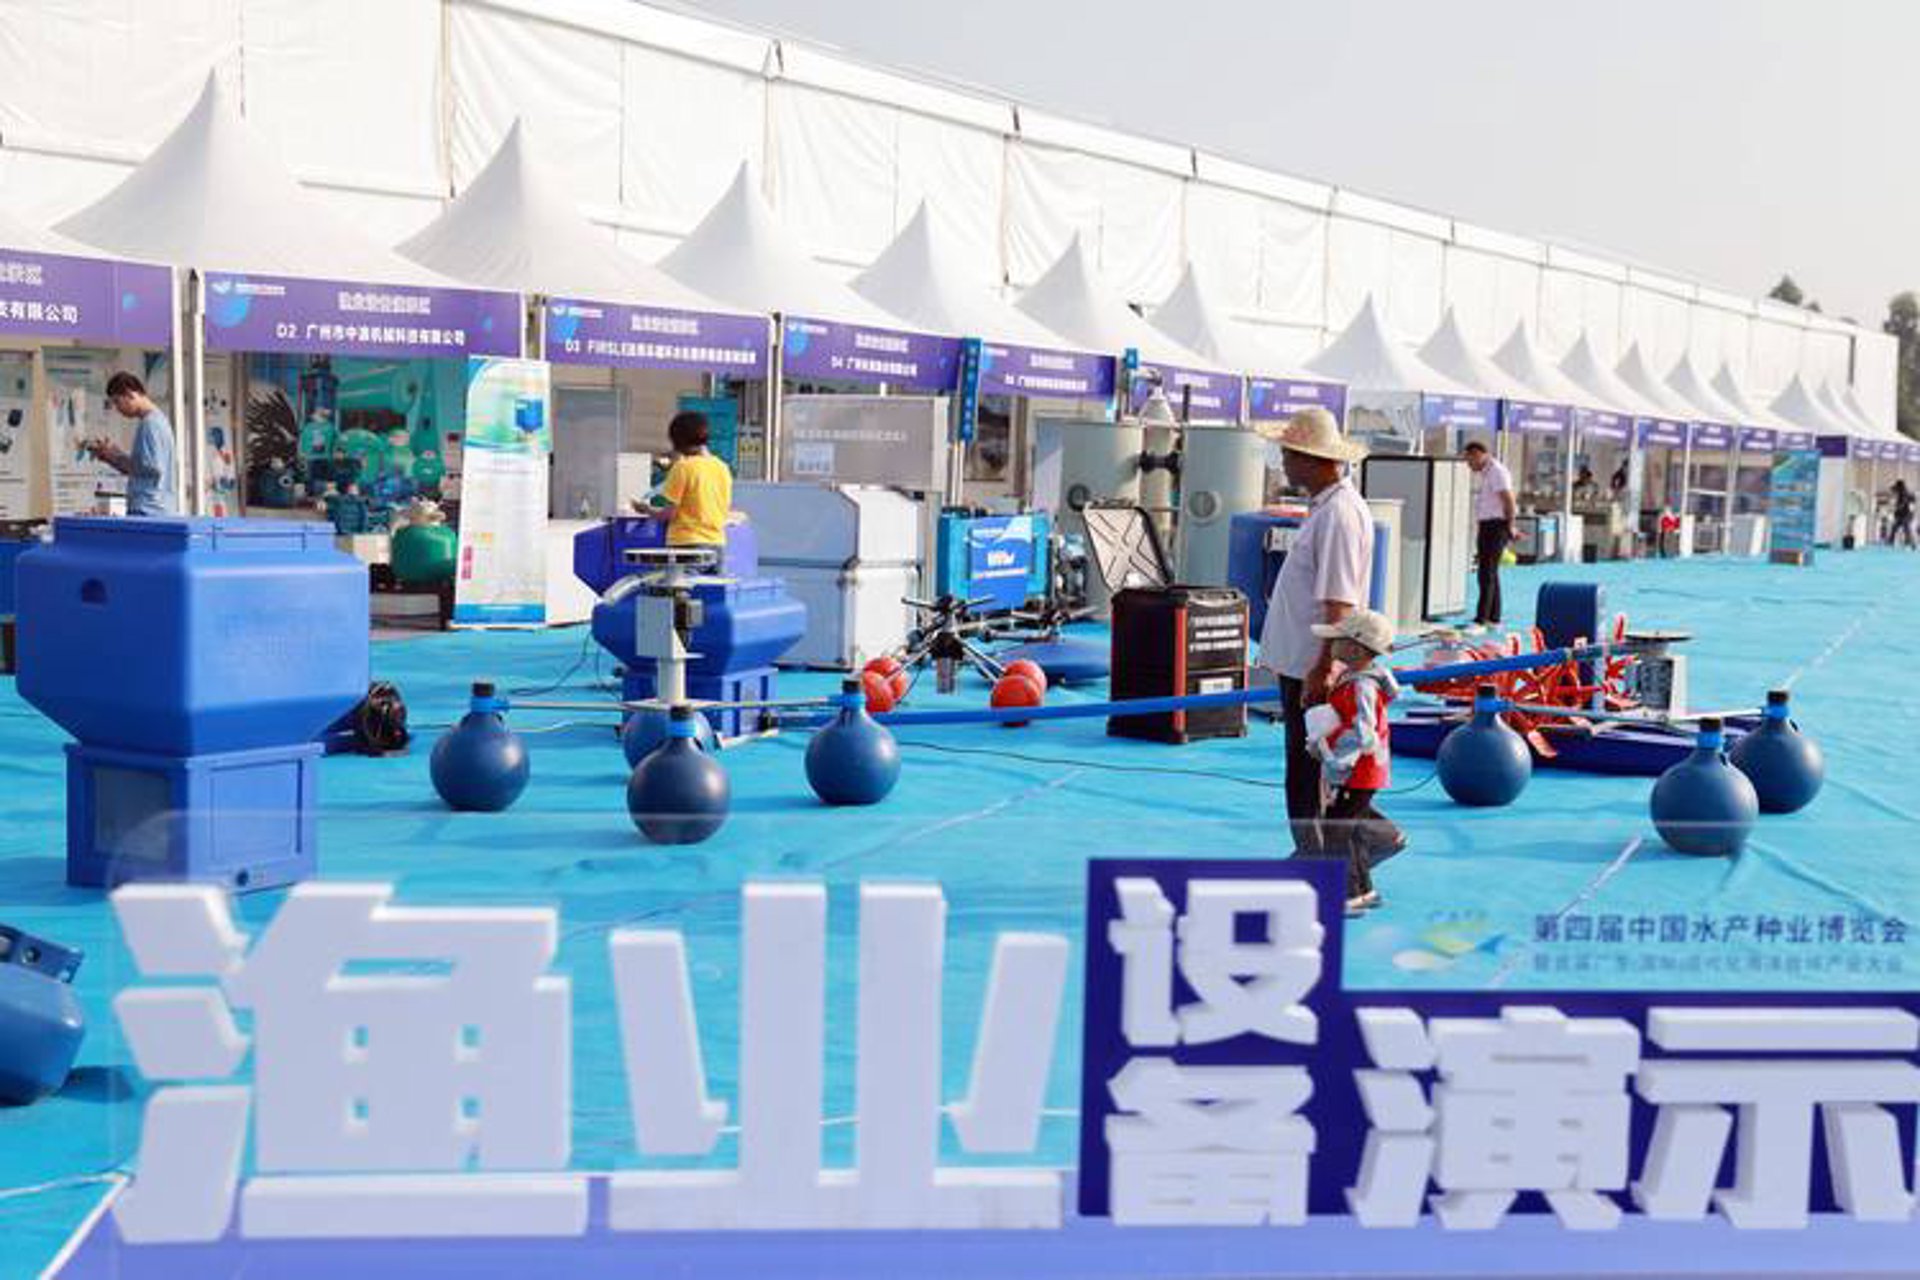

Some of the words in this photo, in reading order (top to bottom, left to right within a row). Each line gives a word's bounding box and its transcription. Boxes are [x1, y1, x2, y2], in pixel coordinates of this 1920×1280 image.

[276, 322, 297, 339] D2
[1534, 913, 1908, 943] 第四届中国水产种业博览会
[110, 880, 1069, 1243] 渔业
[1343, 1005, 1919, 1230] 演示
